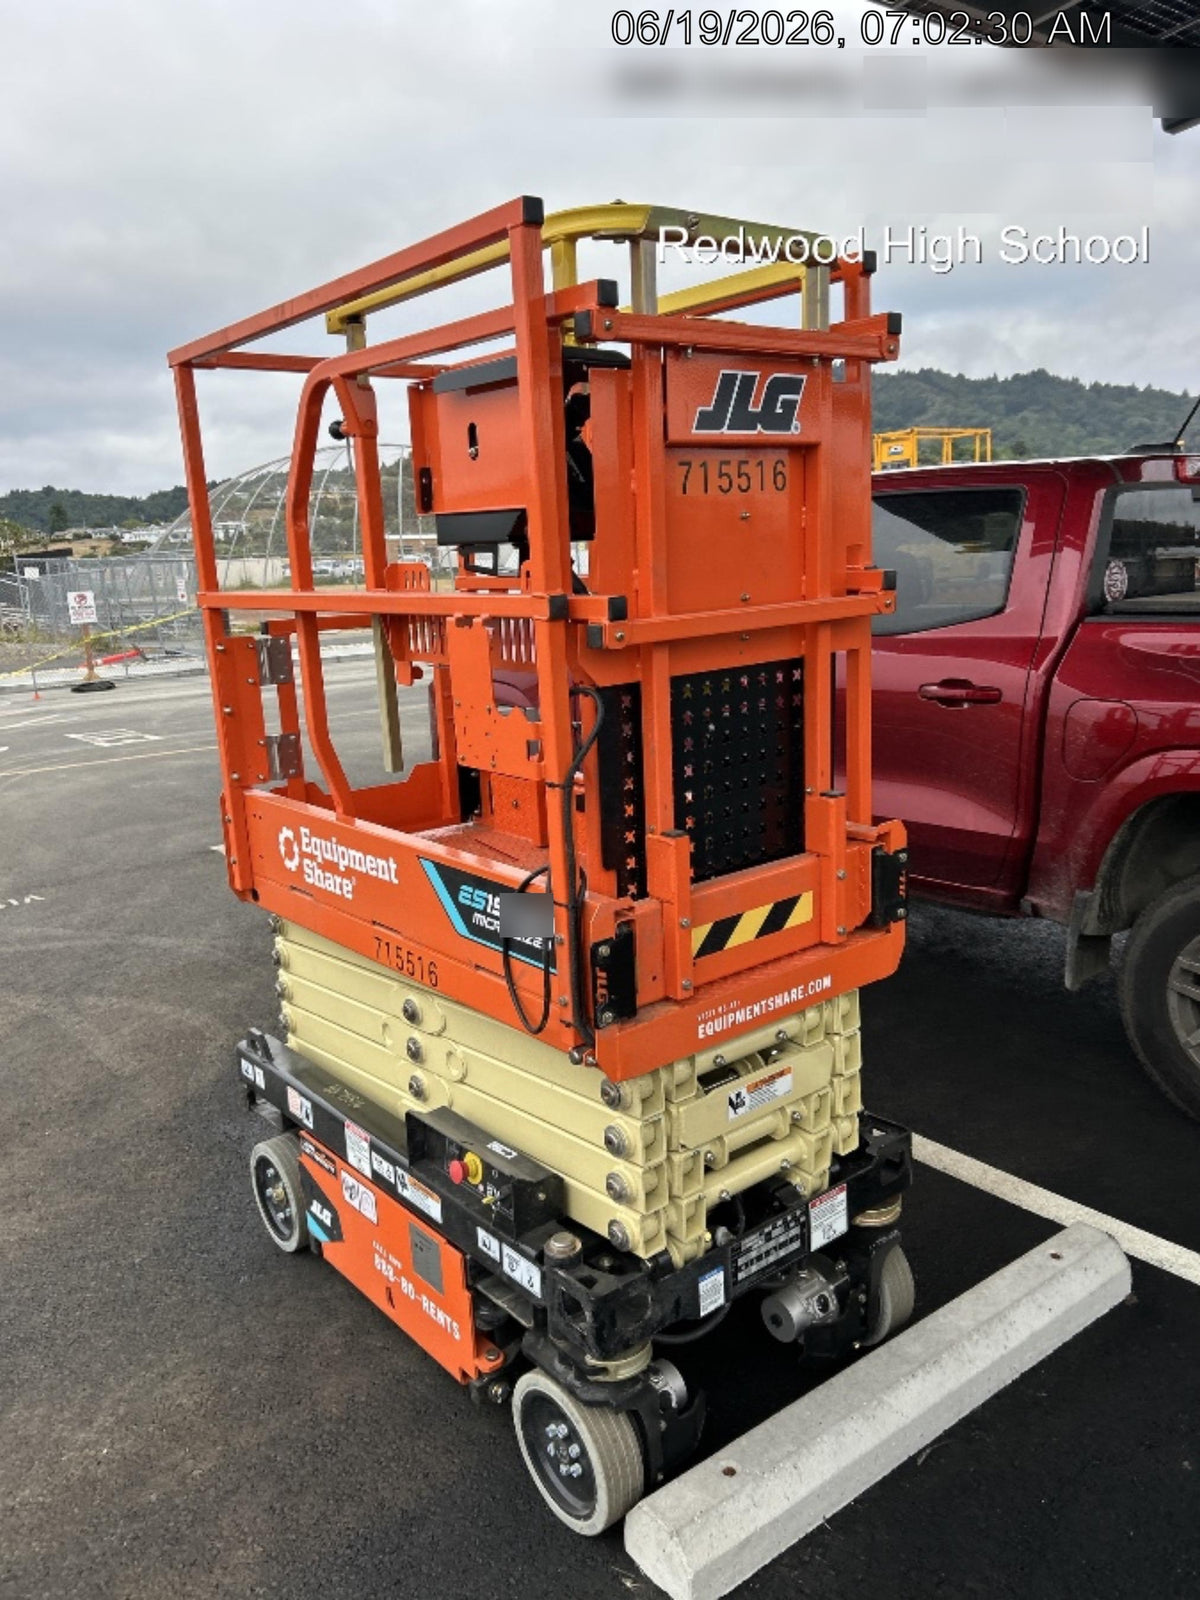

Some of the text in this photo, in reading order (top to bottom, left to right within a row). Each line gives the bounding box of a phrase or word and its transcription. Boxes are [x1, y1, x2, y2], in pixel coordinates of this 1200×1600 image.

[691, 369, 807, 435] JLG
[677, 458, 788, 495] 715516
[299, 825, 399, 885] Equipment
[303, 857, 354, 900] Share
[373, 935, 439, 988] 715516
[697, 974, 832, 1040] EQUIPMENTSHARE.COM
